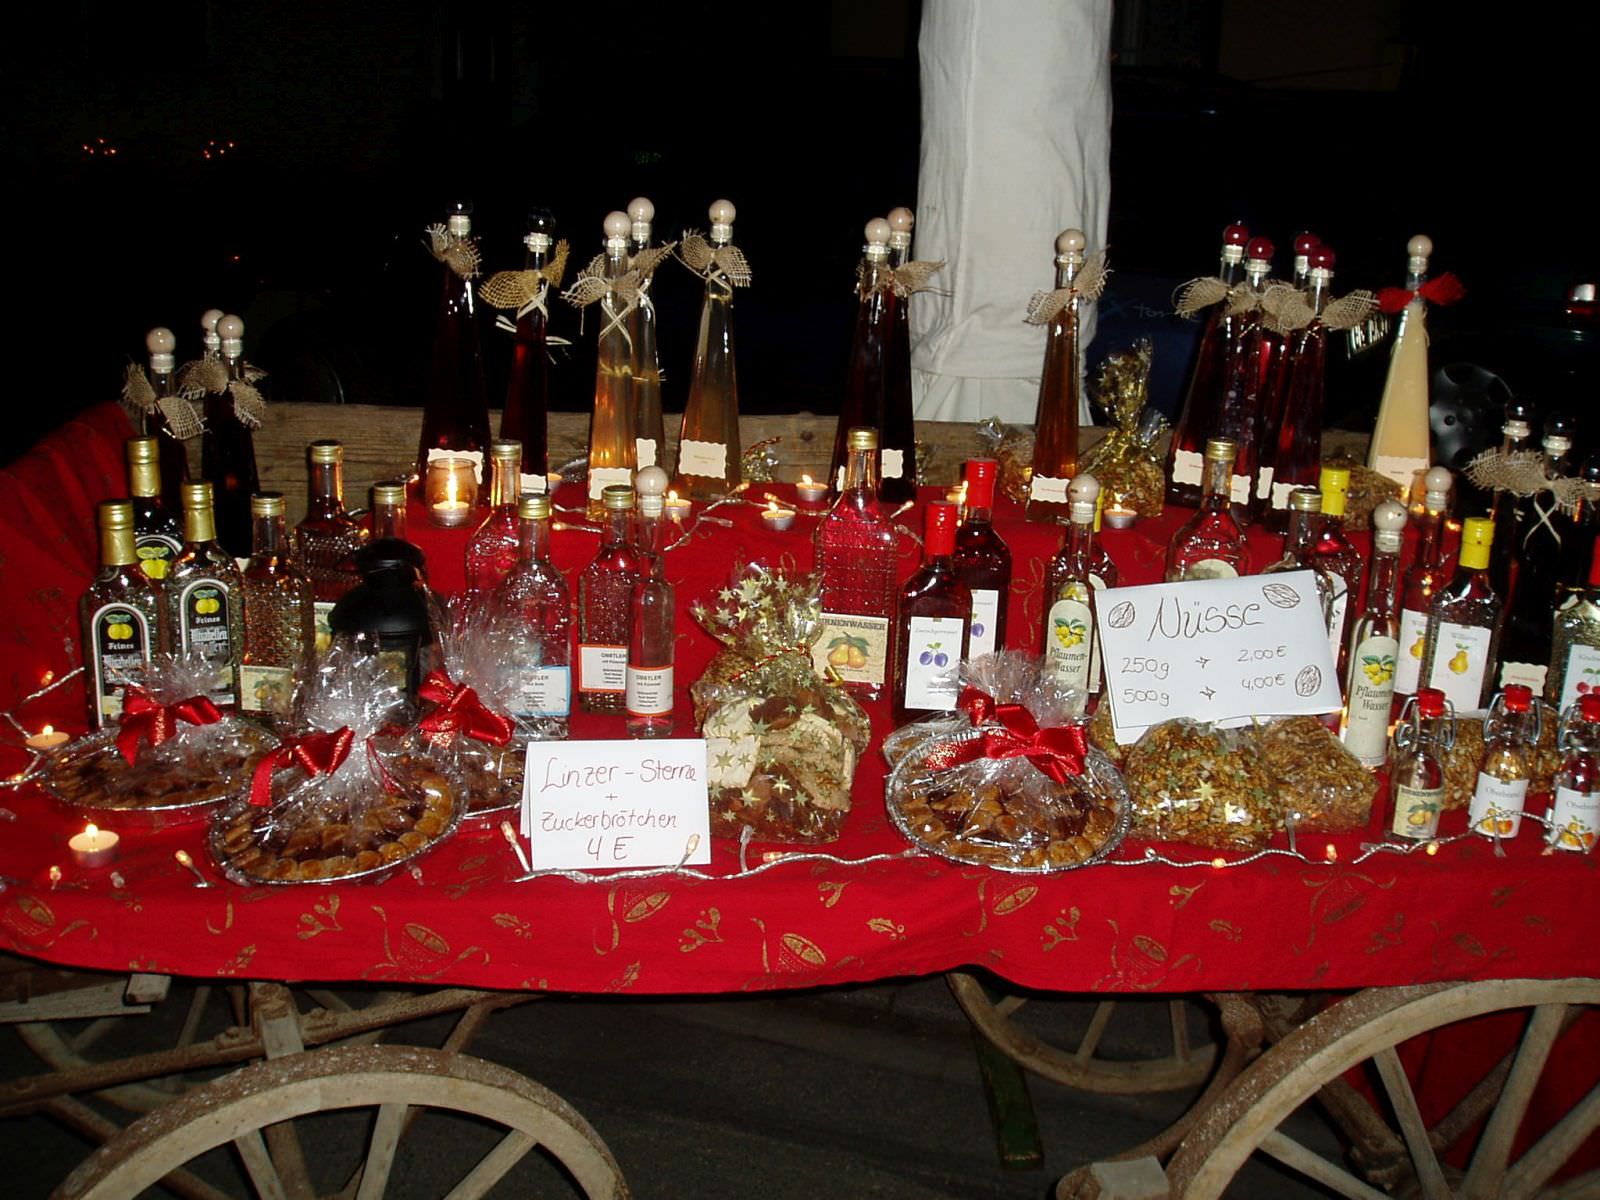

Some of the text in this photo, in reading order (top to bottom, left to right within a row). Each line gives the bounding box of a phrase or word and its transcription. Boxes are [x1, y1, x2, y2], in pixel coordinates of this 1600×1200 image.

[1147, 596, 1264, 642] Nüsse
[1121, 645, 1288, 680] 250g 2,00€
[1123, 673, 1287, 706] 500g 4,00€
[540, 756, 620, 793] Linzer
[640, 758, 698, 784] Sterne
[587, 835, 603, 861] 4
